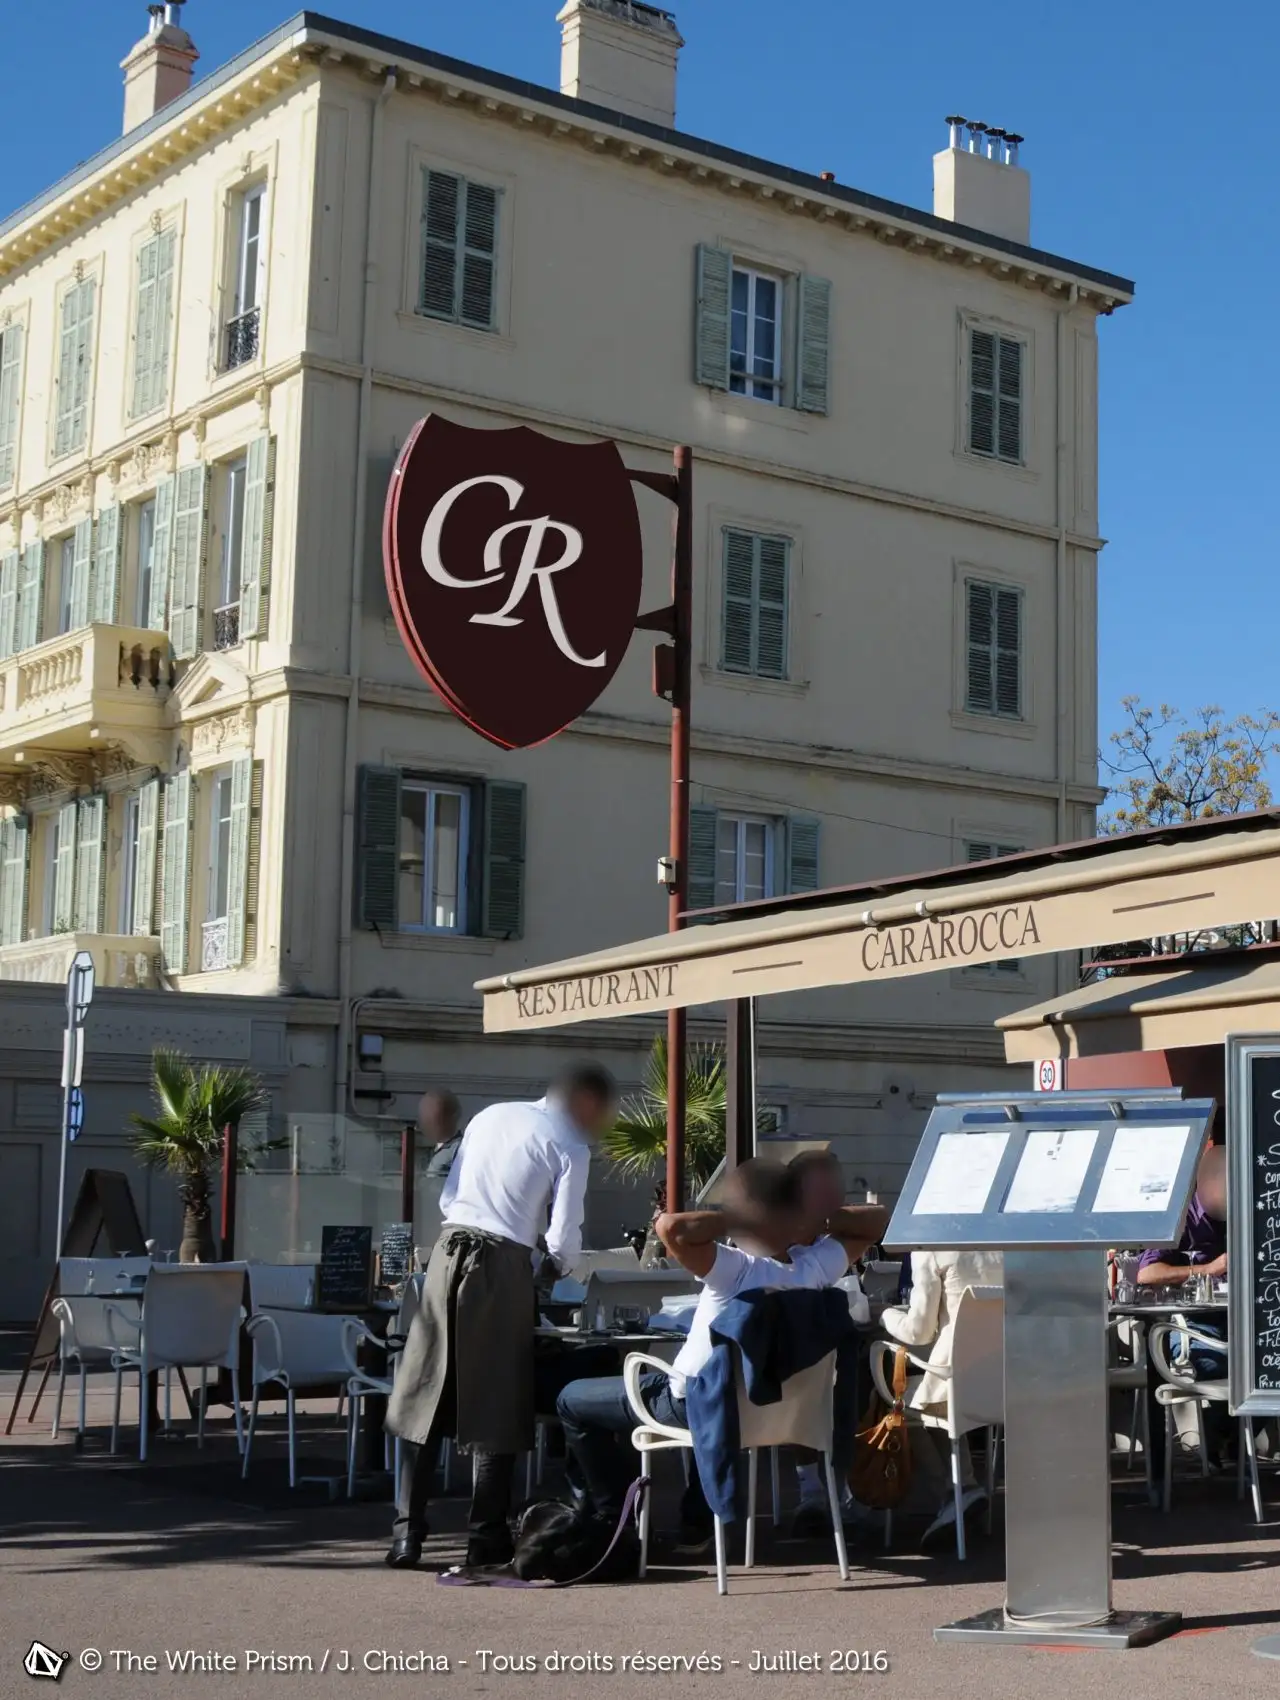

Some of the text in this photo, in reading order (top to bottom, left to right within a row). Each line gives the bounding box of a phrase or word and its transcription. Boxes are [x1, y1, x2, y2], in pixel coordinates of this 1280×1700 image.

[515, 961, 679, 1020] RESTAURANT
[861, 904, 1043, 973] CARAROCCA
[1042, 1067, 1053, 1084] 30
[1259, 1374, 1273, 1388] Prix
